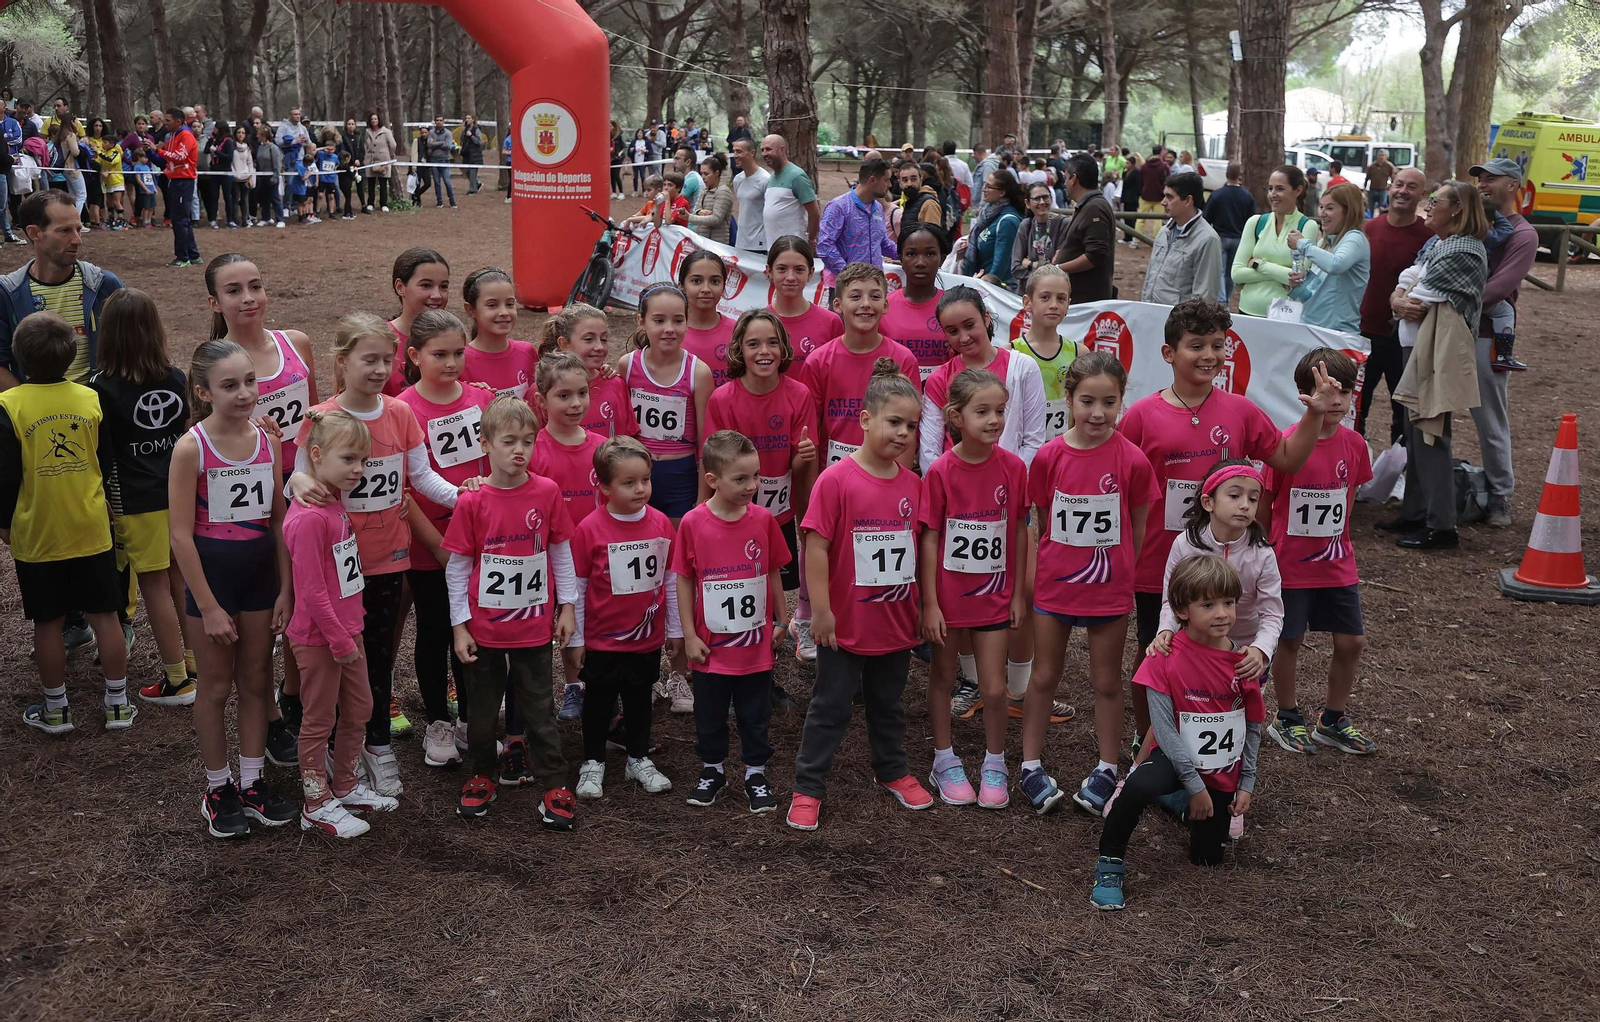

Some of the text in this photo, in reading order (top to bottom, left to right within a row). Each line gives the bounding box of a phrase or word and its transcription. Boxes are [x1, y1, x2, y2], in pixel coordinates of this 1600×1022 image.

[1502, 129, 1536, 139] AMBULANCIA
[547, 172, 556, 183] de
[558, 173, 591, 184] Deportes
[565, 184, 575, 192] San
[256, 391, 286, 406] CROSS
[636, 393, 660, 402] CROSS
[828, 399, 862, 408] ATLET
[267, 400, 304, 428] 22
[634, 405, 678, 430] 166
[828, 410, 860, 418] INMAC
[1046, 411, 1065, 429] 73
[25, 414, 58, 439] ATLETISMO
[60, 413, 93, 428] ESTEPONA
[437, 414, 464, 427] CROSS
[1165, 450, 1218, 460] INMACULADA
[366, 459, 384, 468] OSS
[220, 468, 251, 477] CROSS
[348, 470, 399, 499] 229
[1178, 482, 1197, 490] CRO
[230, 480, 264, 508] 21
[764, 485, 788, 508] 76
[1060, 495, 1090, 505] CROSS
[1301, 491, 1331, 499] CROSS
[1296, 503, 1344, 526] 179
[853, 518, 902, 527] INMACULADA
[957, 522, 987, 530] CROSS
[1056, 509, 1112, 534] 175
[864, 533, 896, 542] CROSS
[619, 542, 650, 551] CROSS
[950, 535, 1002, 561] 268
[492, 557, 524, 566] CROSS
[872, 547, 907, 573] 17
[627, 554, 658, 580] 19
[702, 563, 752, 575] INMACULADA
[485, 568, 542, 596] 214
[713, 582, 745, 591] CROSS
[721, 594, 756, 620] 18
[1197, 728, 1235, 756] 24
